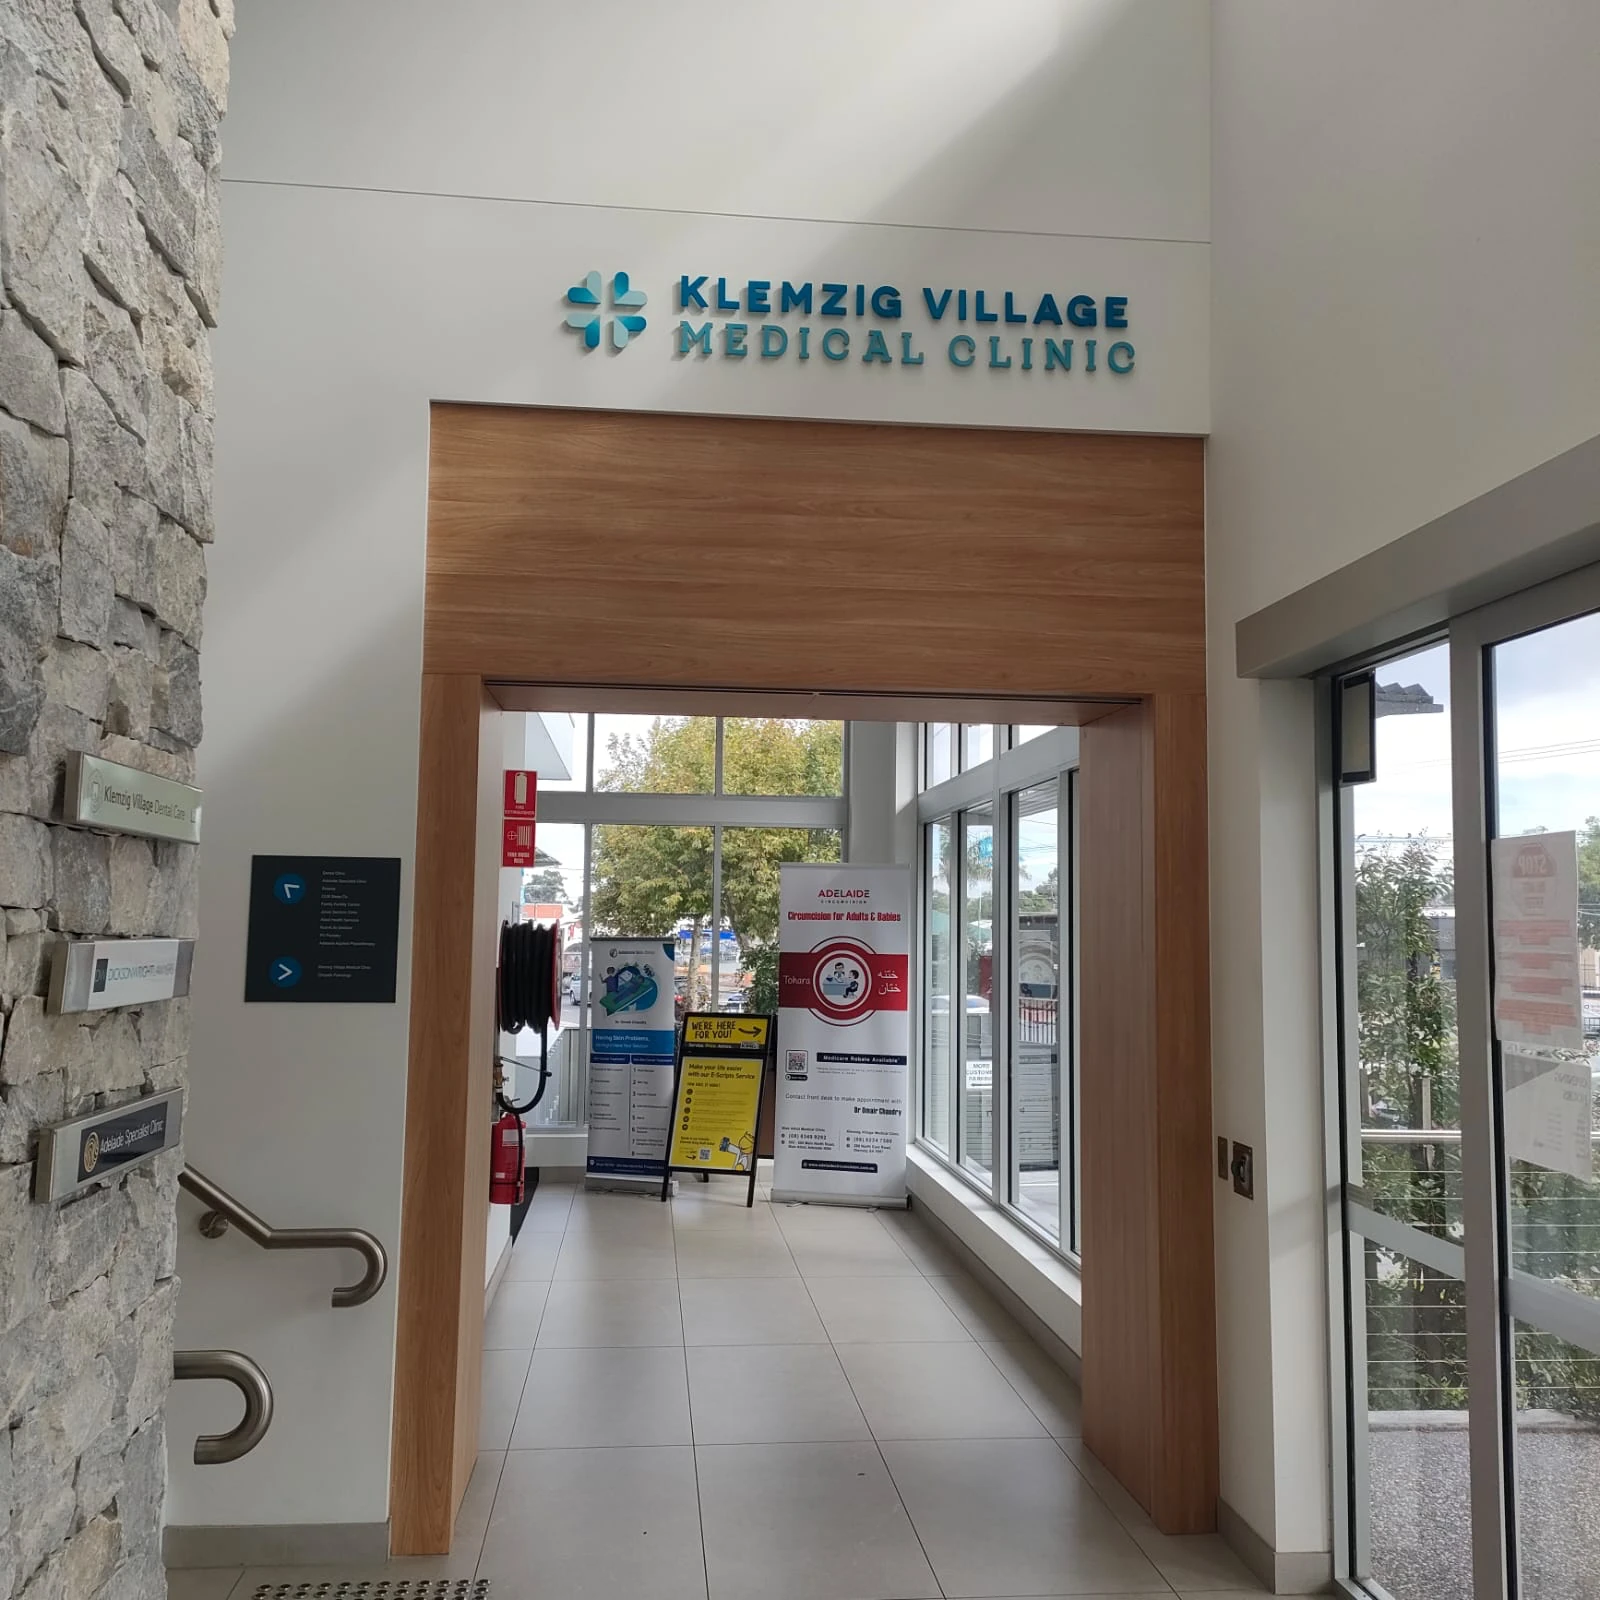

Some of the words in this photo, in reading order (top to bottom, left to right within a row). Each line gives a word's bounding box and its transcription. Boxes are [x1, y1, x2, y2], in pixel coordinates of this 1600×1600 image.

[679, 275, 902, 319] KLEMZIG
[922, 287, 1129, 328] VILLAGE
[679, 320, 924, 365] MEDICAL
[947, 334, 1136, 374] CLINIC
[104, 785, 132, 811] Klemzig
[132, 791, 154, 815] Village
[154, 800, 173, 816] Dental
[174, 805, 186, 821] Care
[817, 889, 870, 898] ADELAIDE
[787, 911, 832, 921] Circumcision
[833, 911, 845, 921] for
[846, 911, 869, 921] Adults
[877, 912, 902, 922] Babies
[716, 1020, 737, 1030] HERE
[695, 1030, 710, 1039] FOR
[712, 1030, 733, 1039] YOU!
[785, 1092, 806, 1100] Contact
[854, 1106, 861, 1114] Dr
[100, 1134, 124, 1153] Adelaide
[124, 1122, 149, 1147] Specialist
[149, 1119, 164, 1136] Clinic
